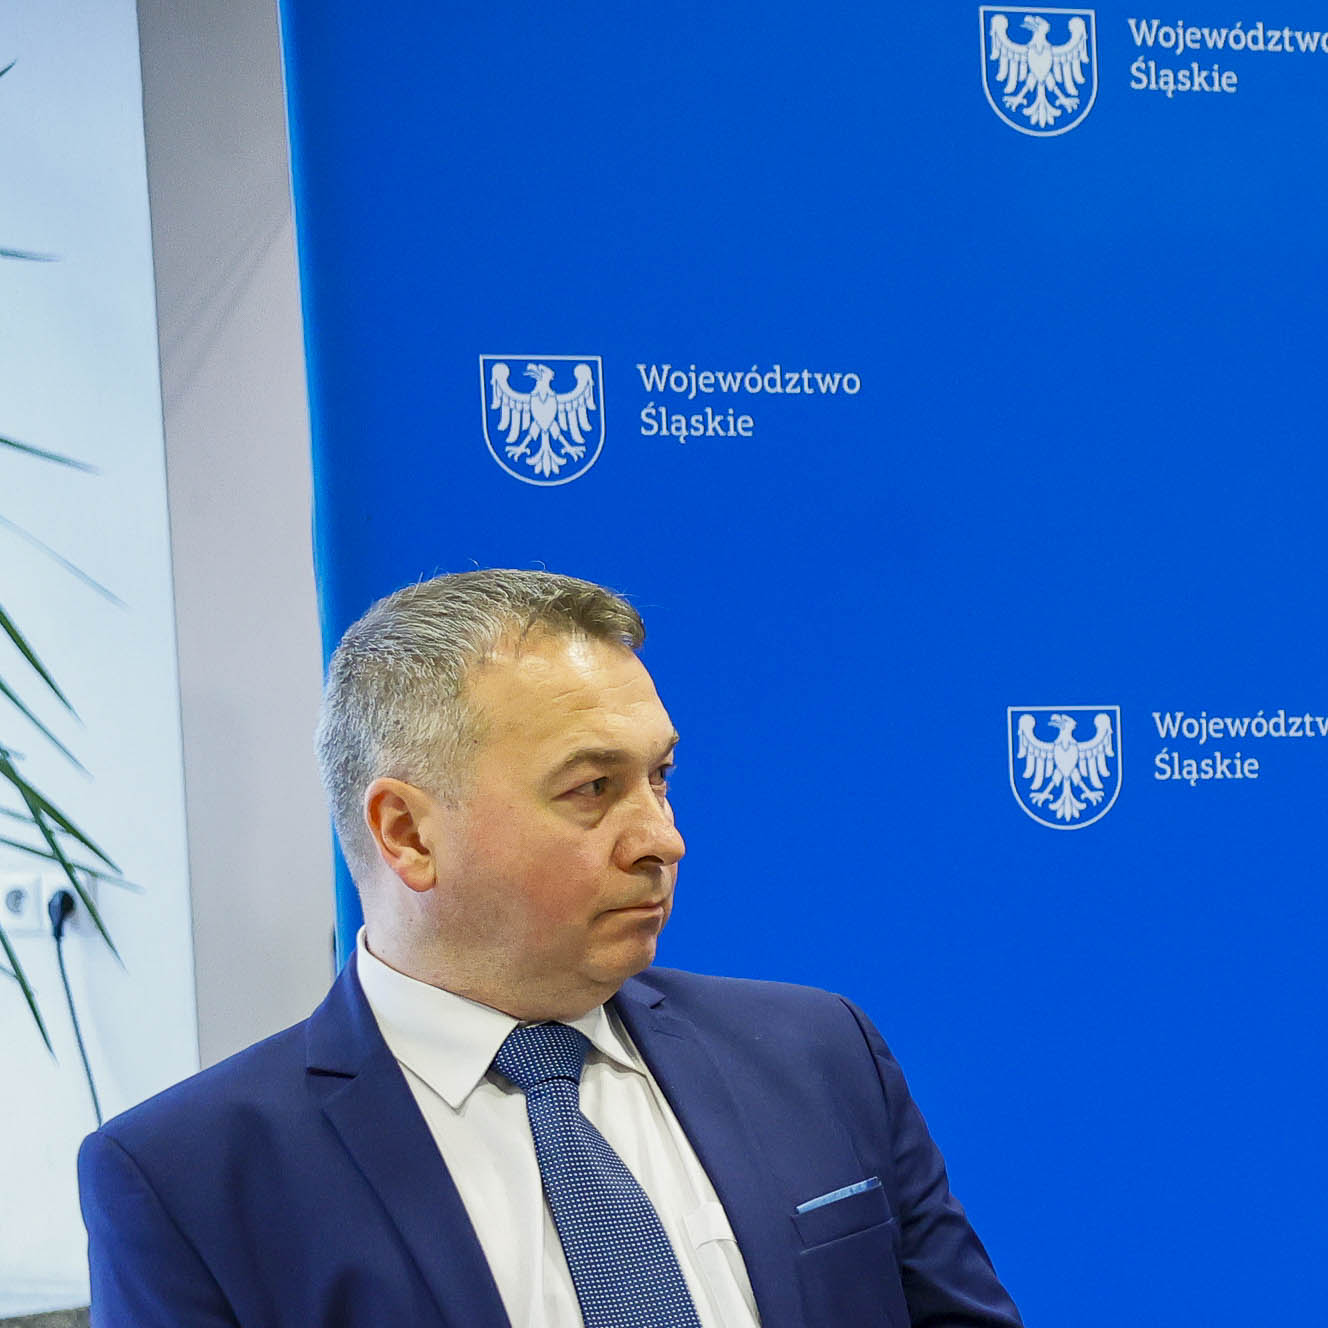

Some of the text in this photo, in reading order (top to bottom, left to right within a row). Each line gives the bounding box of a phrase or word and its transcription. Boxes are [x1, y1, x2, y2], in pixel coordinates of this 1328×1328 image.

[1131, 56, 1238, 98] Śląskie
[637, 363, 861, 400] Województwo
[640, 401, 754, 444] Śląskie
[1154, 747, 1260, 784] Śląskie
